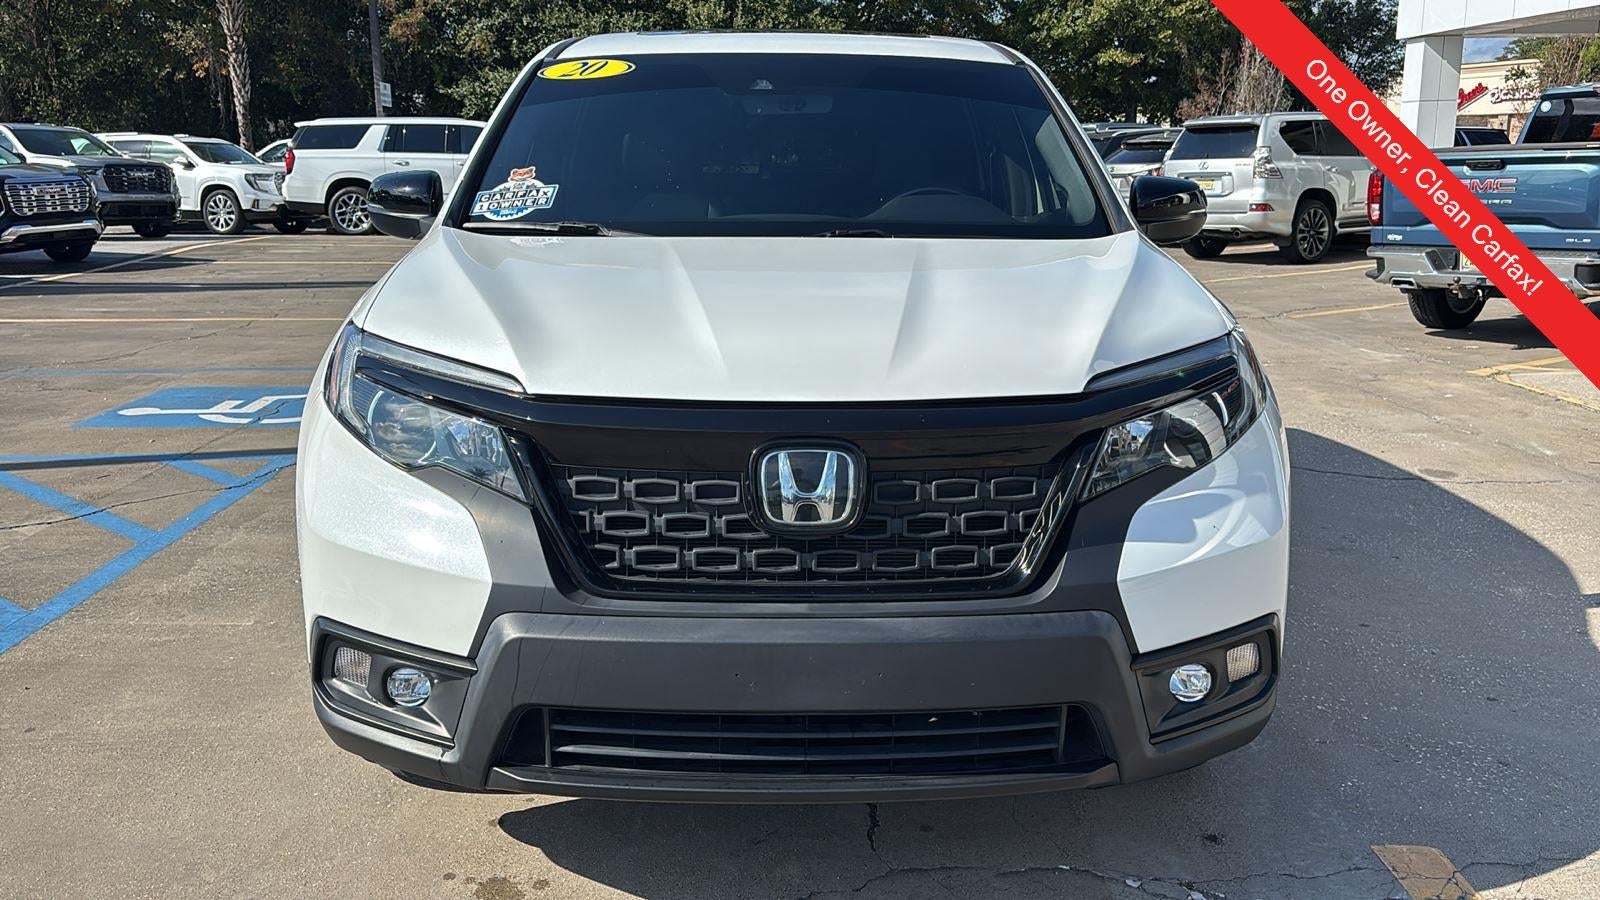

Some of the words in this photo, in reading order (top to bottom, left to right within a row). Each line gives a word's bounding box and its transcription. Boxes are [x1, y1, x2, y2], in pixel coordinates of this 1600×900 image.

[556, 61, 609, 77] 20
[481, 189, 550, 202] CARFAX
[488, 198, 547, 210] OWNER
